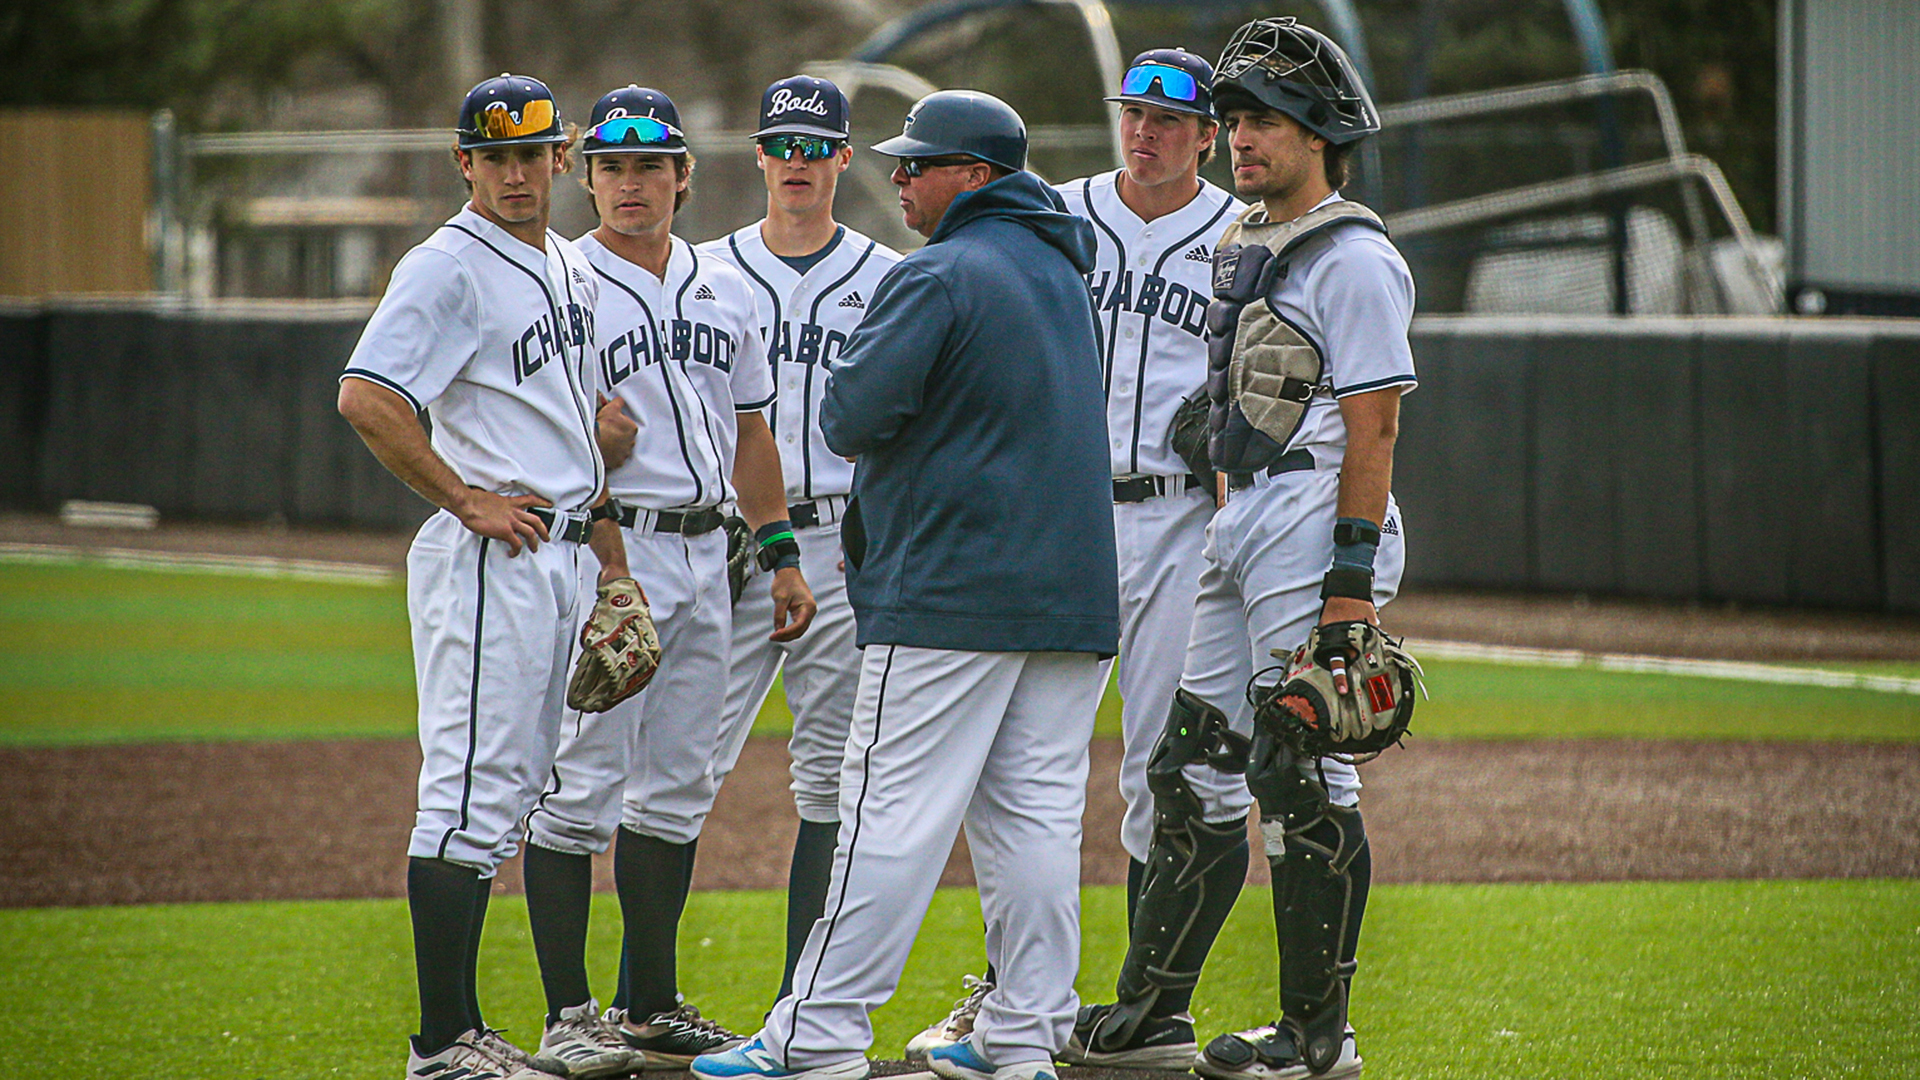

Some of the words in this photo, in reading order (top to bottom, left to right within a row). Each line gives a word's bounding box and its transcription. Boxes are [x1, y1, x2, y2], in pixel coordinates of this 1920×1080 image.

[767, 87, 828, 118] Bods
[1087, 270, 1212, 343] HABOD
[760, 320, 847, 370] ABO
